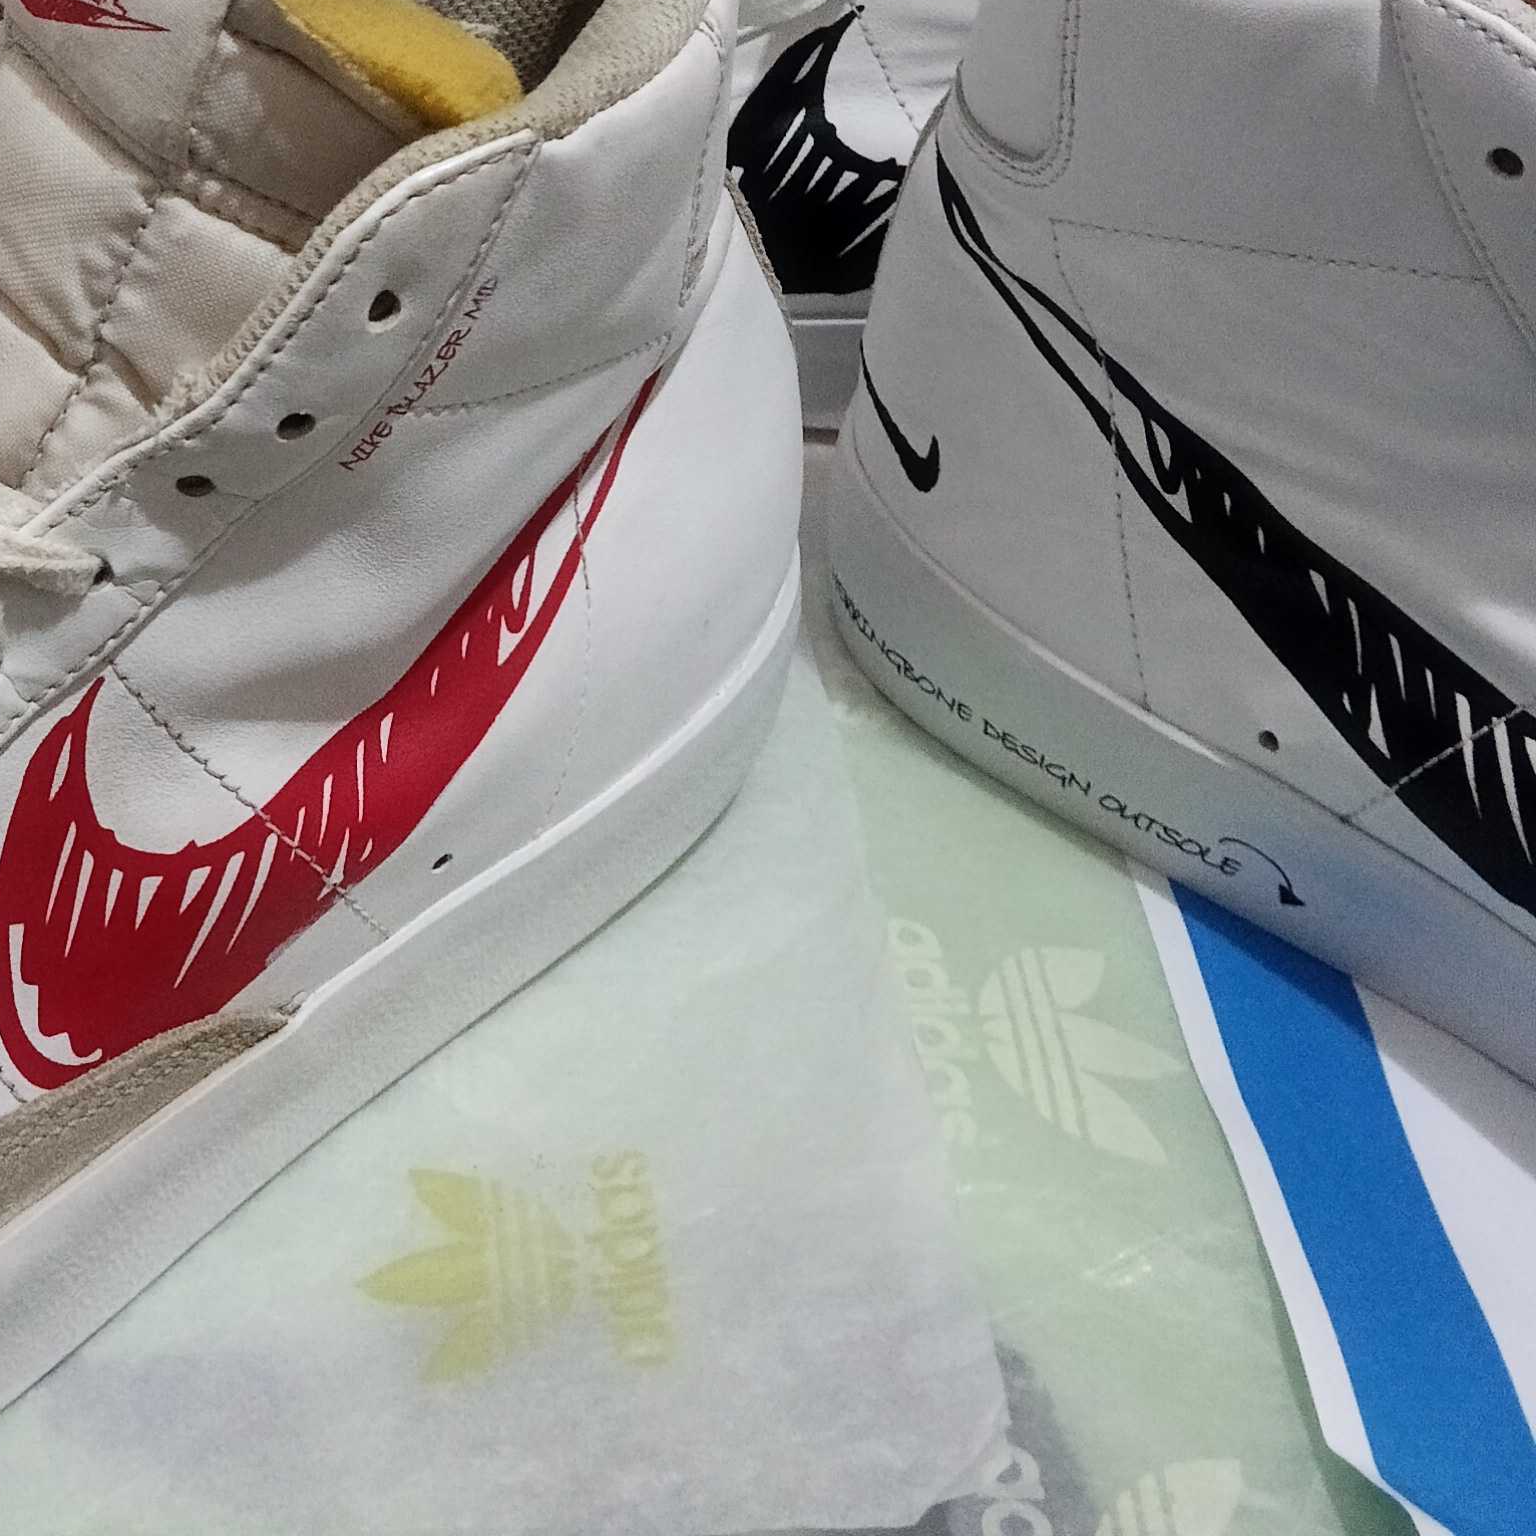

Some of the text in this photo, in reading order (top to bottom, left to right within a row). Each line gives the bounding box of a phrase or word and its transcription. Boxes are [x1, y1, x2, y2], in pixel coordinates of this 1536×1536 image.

[339, 420, 393, 472] NIKE
[982, 718, 1092, 796] DESIGN
[1098, 794, 1242, 876] OUTSOLE
